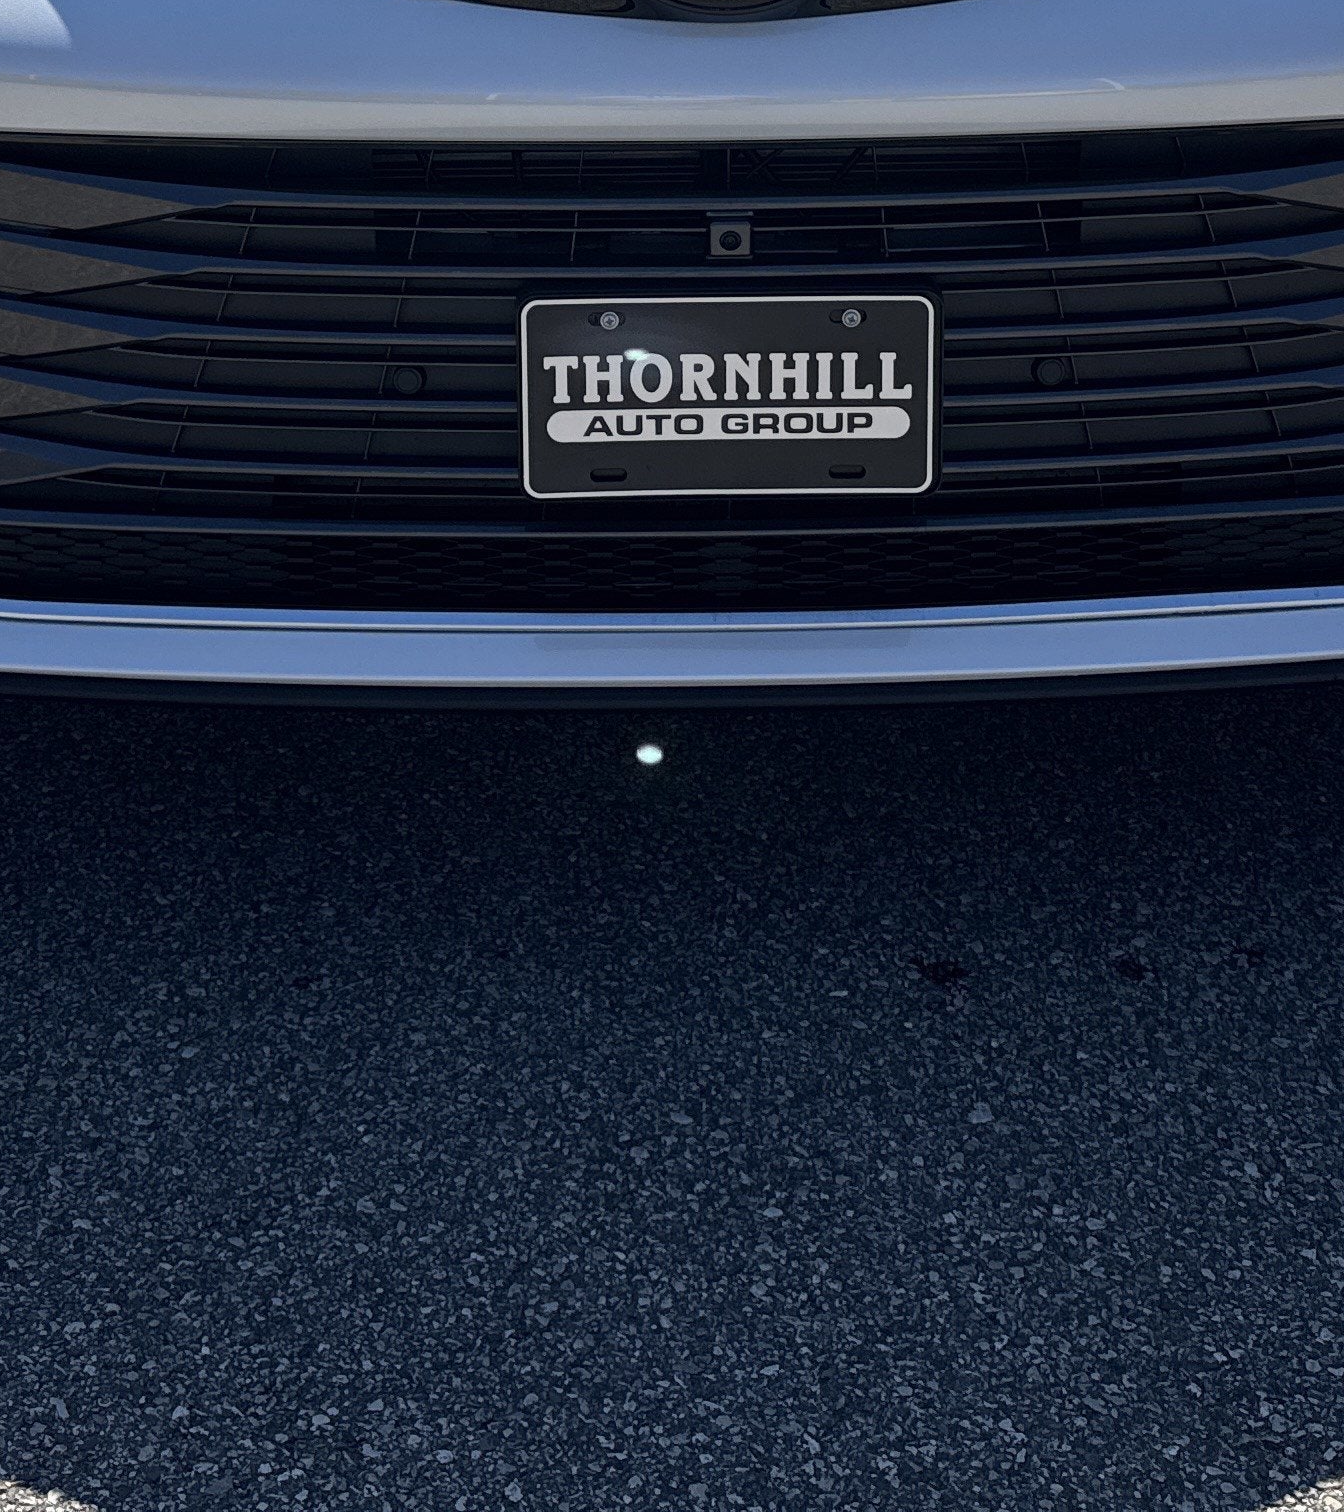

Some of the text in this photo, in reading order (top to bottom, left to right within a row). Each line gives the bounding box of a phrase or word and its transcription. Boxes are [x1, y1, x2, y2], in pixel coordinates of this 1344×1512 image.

[543, 352, 912, 403] THORNHILL
[583, 412, 873, 437] AUTO GROUP
